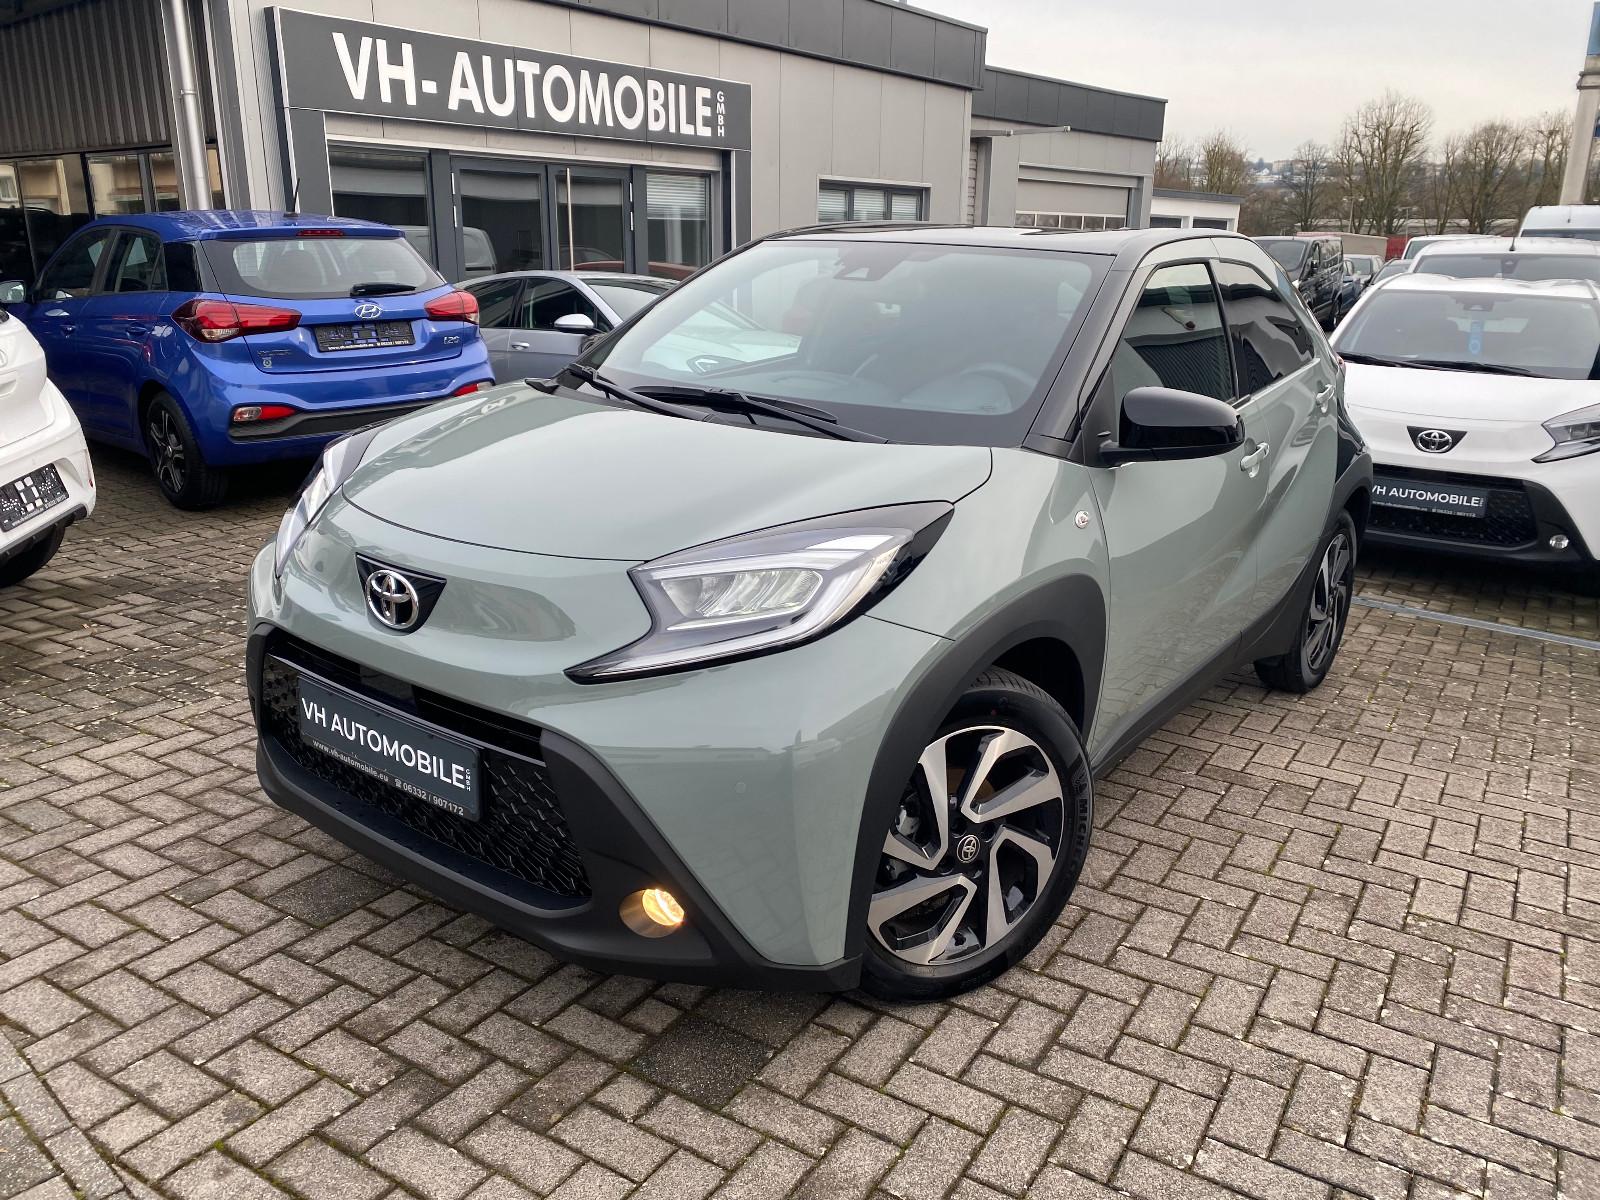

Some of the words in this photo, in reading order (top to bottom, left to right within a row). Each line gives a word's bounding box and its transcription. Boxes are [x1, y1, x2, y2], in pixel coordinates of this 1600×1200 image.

[332, 32, 437, 106] VH-
[447, 51, 712, 137] AUTOMOBILE
[716, 90, 726, 137] GMBH
[1388, 487, 1480, 507] AUTOMOBILE
[301, 697, 327, 728] VH
[330, 712, 465, 789] AUTOMOBILE
[312, 739, 389, 782] www.vh-automobile.eu
[402, 782, 427, 800] 06332
[432, 795, 464, 816] 907172
